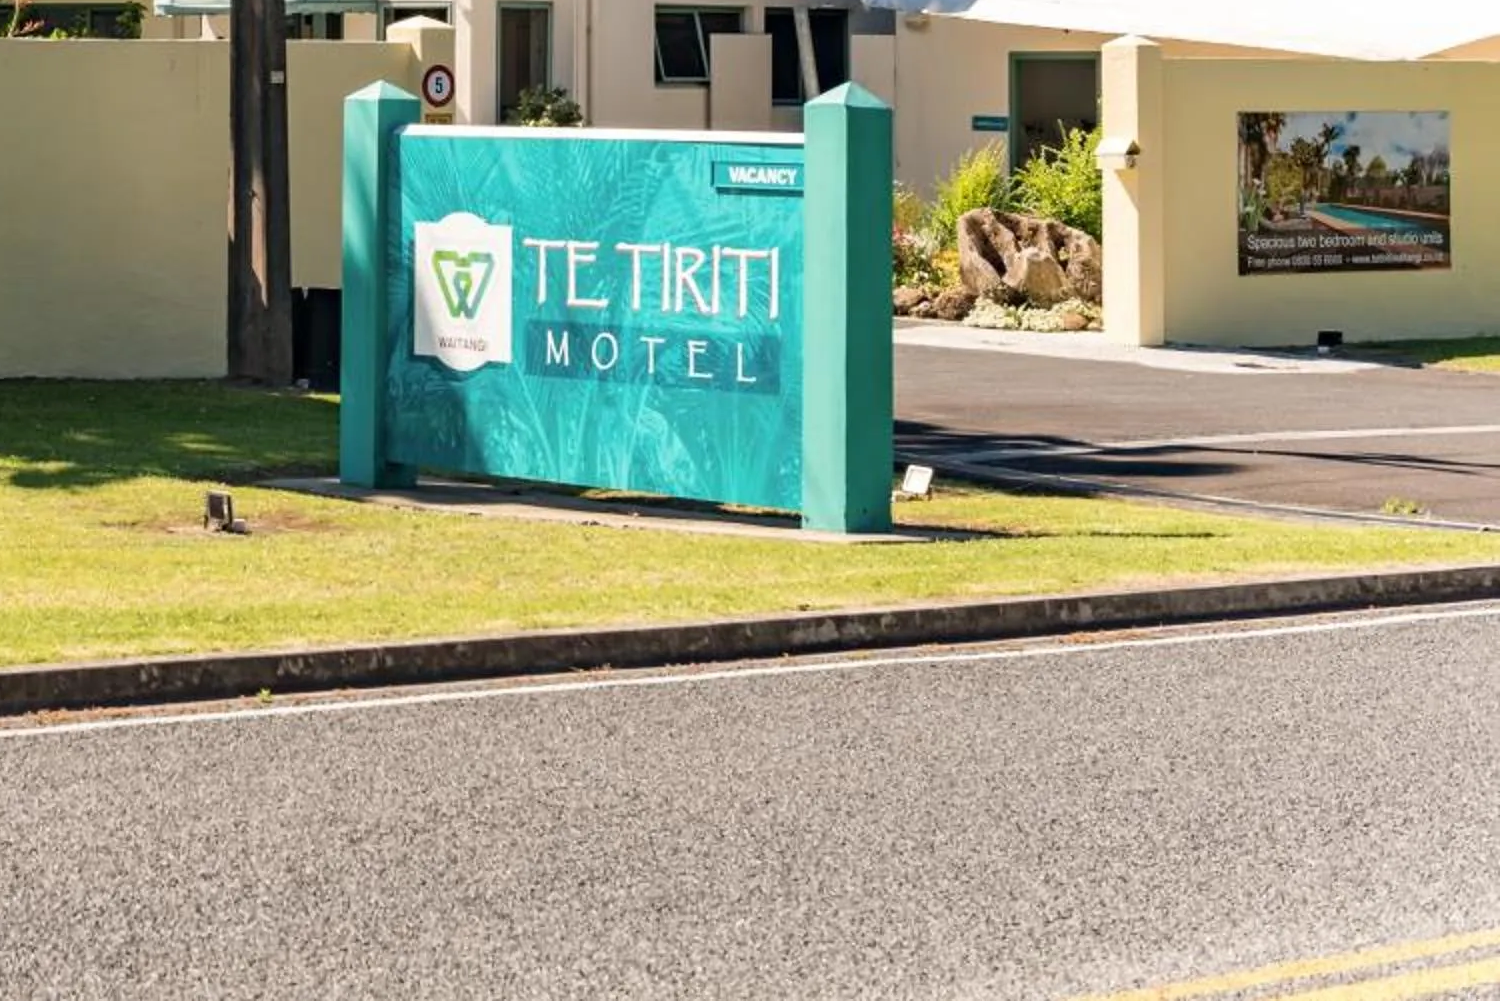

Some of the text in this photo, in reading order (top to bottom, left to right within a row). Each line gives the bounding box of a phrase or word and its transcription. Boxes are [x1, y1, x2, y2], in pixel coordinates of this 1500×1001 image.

[435, 76, 443, 94] 5
[728, 166, 797, 186] VACANCY
[1247, 230, 1444, 251] Spacious two bedroom and studio units
[522, 237, 780, 320] TE TIRITI
[437, 335, 490, 352] WAITANGI
[546, 330, 758, 383] MOTEL
